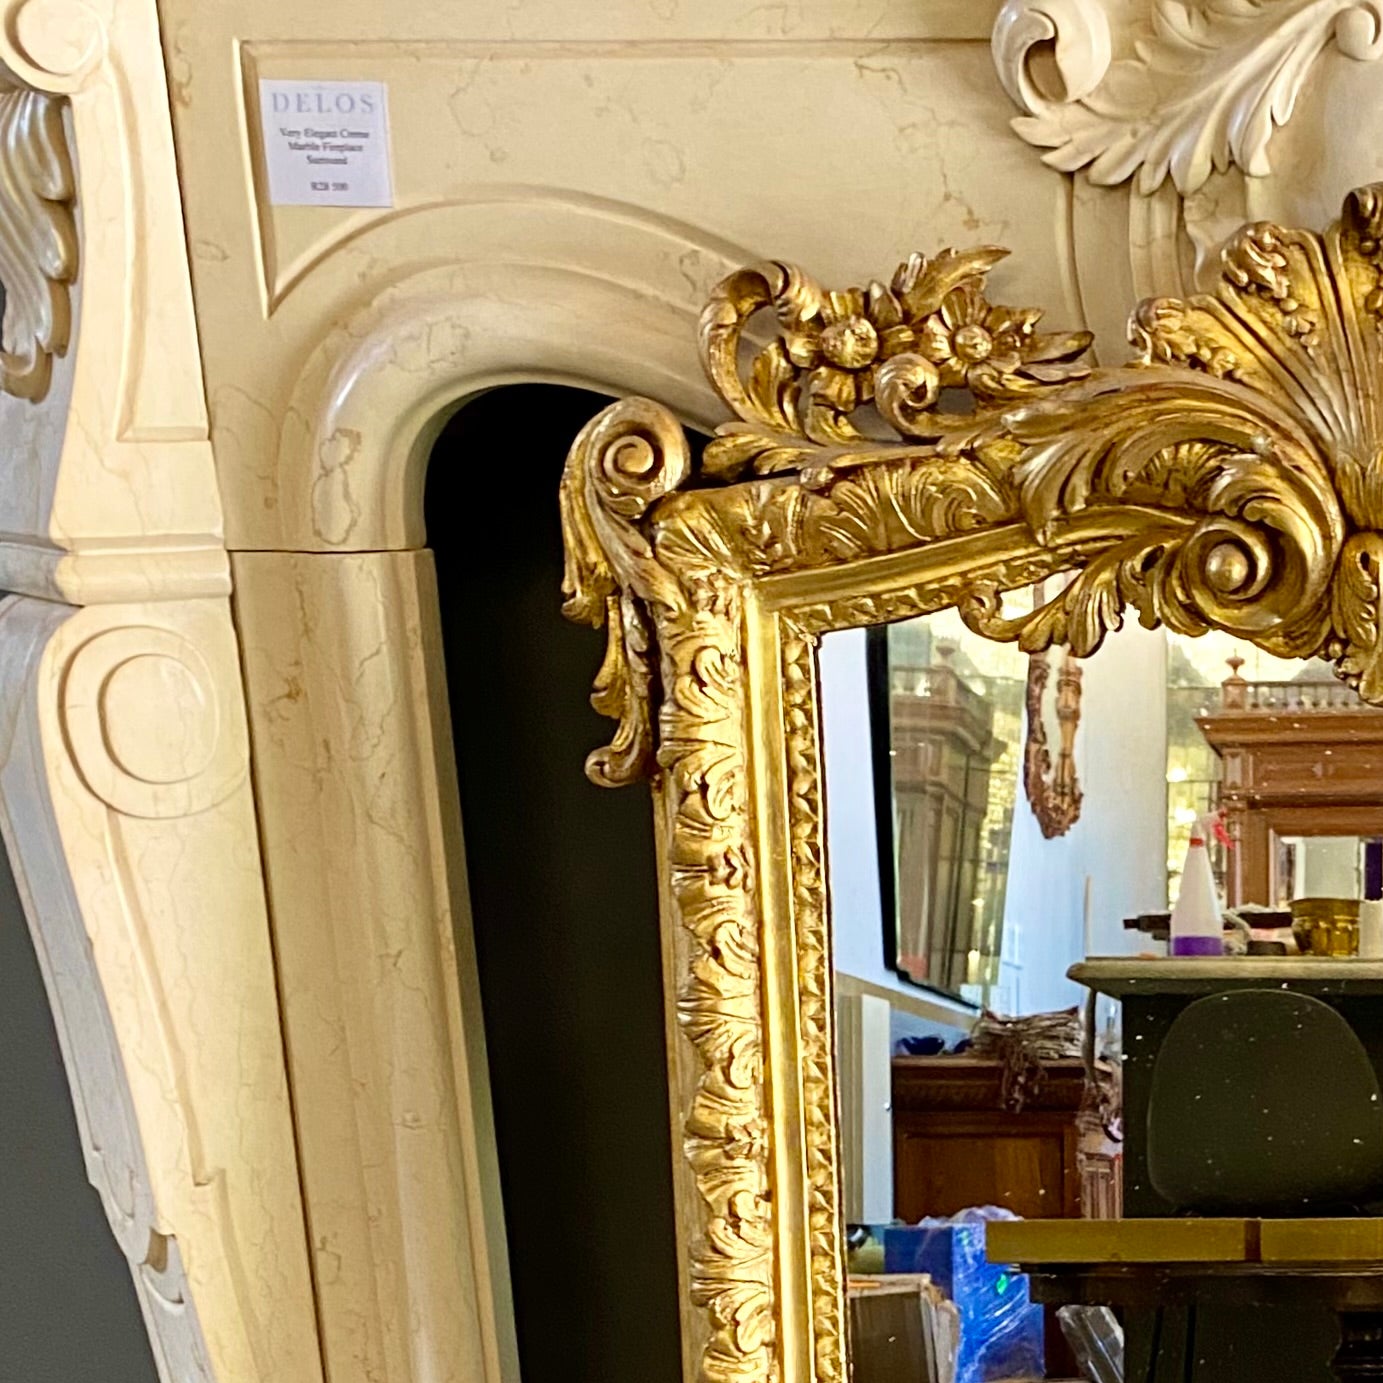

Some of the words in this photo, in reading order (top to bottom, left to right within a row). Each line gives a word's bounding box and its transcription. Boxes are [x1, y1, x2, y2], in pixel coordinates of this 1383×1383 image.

[272, 92, 375, 113] DELOS
[279, 127, 301, 139] Very
[288, 141, 320, 151] Marble
[322, 142, 364, 153] Fireplace
